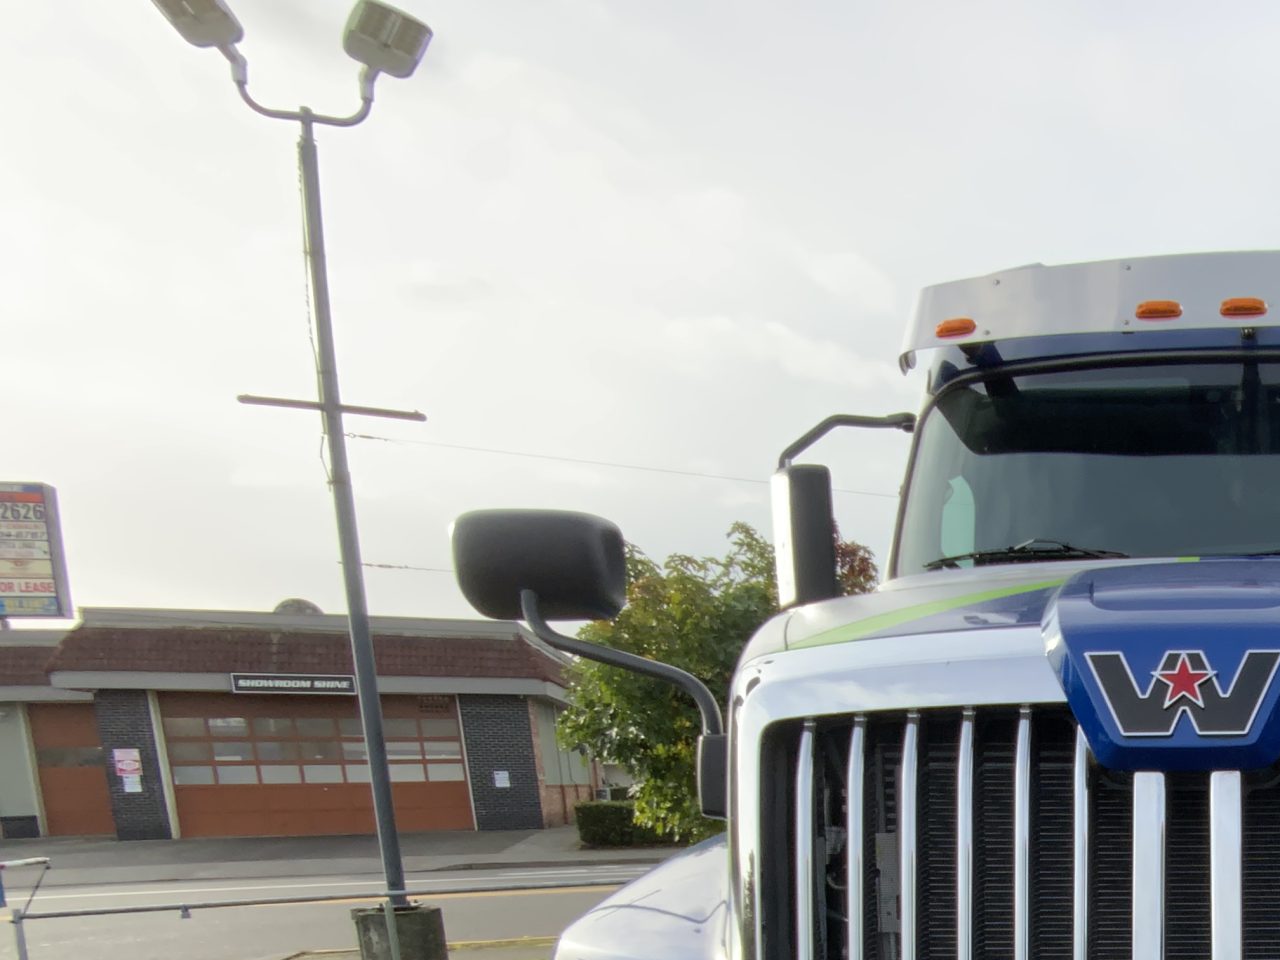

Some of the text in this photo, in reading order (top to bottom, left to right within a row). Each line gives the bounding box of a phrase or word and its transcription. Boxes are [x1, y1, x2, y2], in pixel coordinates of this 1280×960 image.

[19, 582, 55, 593] LEASE
[238, 679, 350, 688] SHOWROOM SHINE
